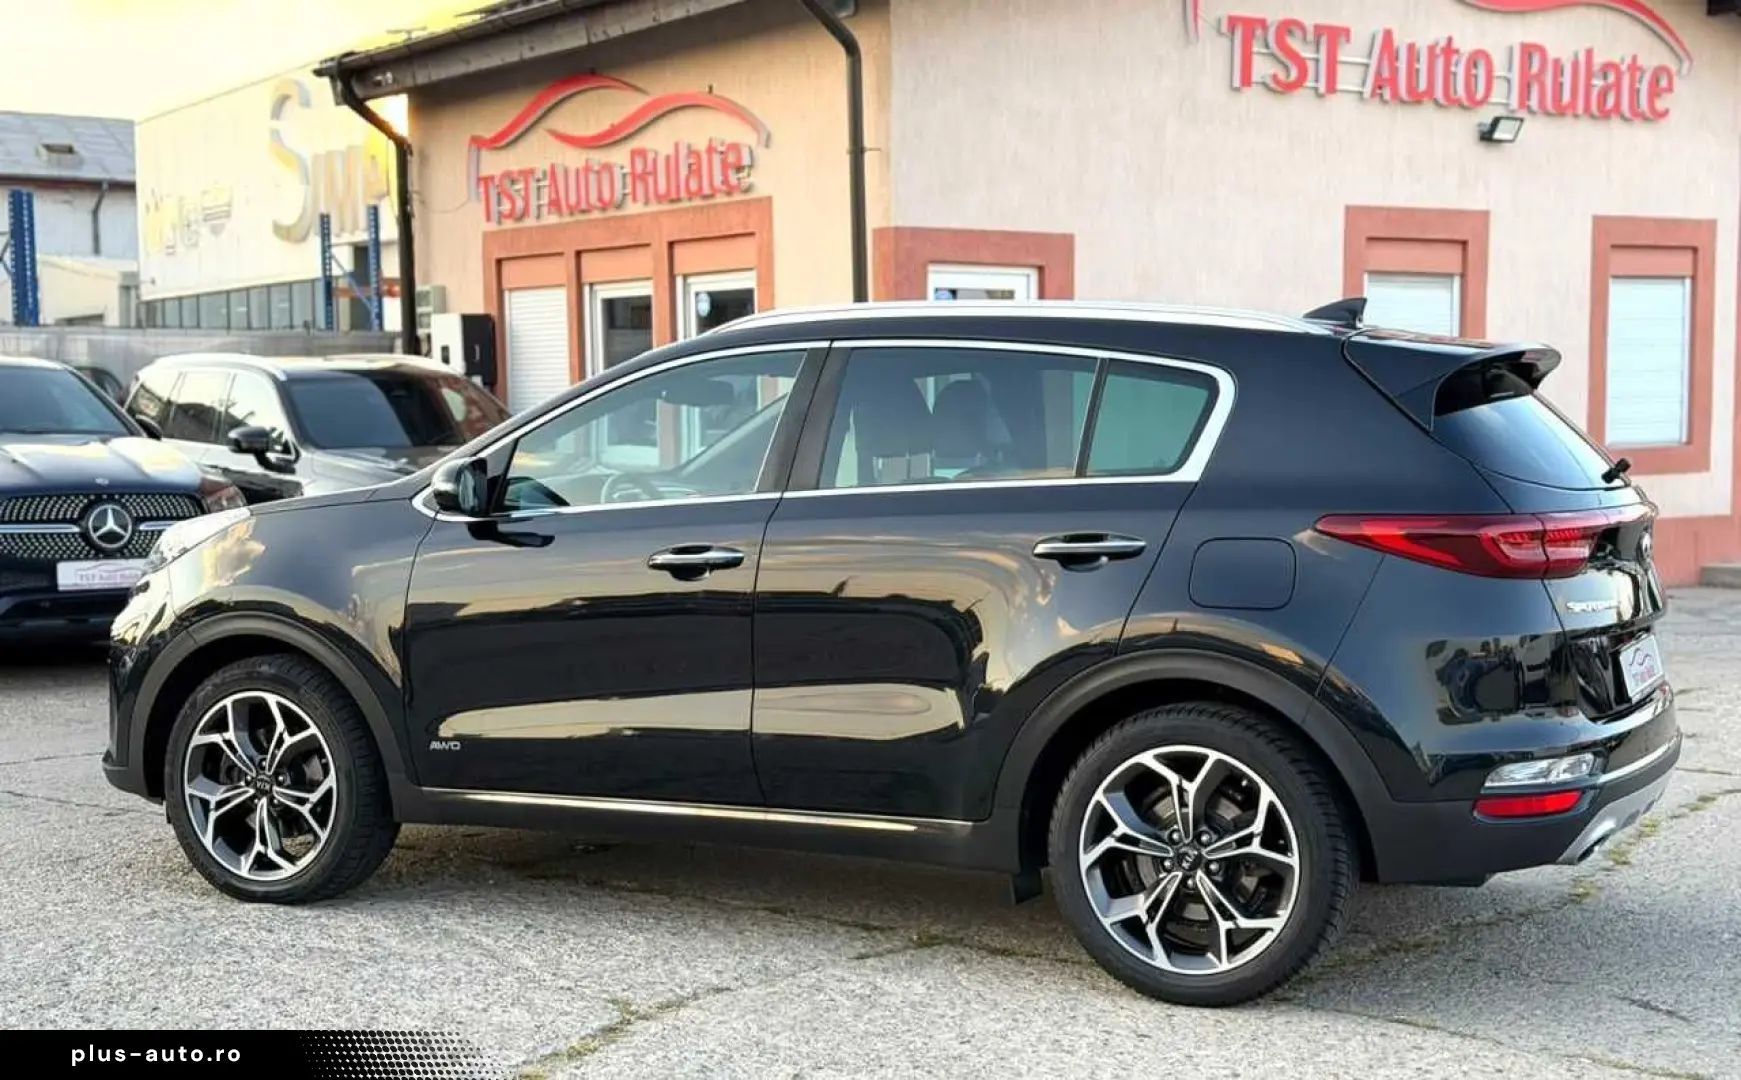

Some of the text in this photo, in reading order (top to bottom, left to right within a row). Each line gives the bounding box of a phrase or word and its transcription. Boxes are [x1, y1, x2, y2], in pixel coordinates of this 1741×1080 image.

[1226, 14, 1676, 121] TST Auto Rulate
[478, 138, 754, 224] TST Auto Rulate
[429, 740, 462, 752] AWD
